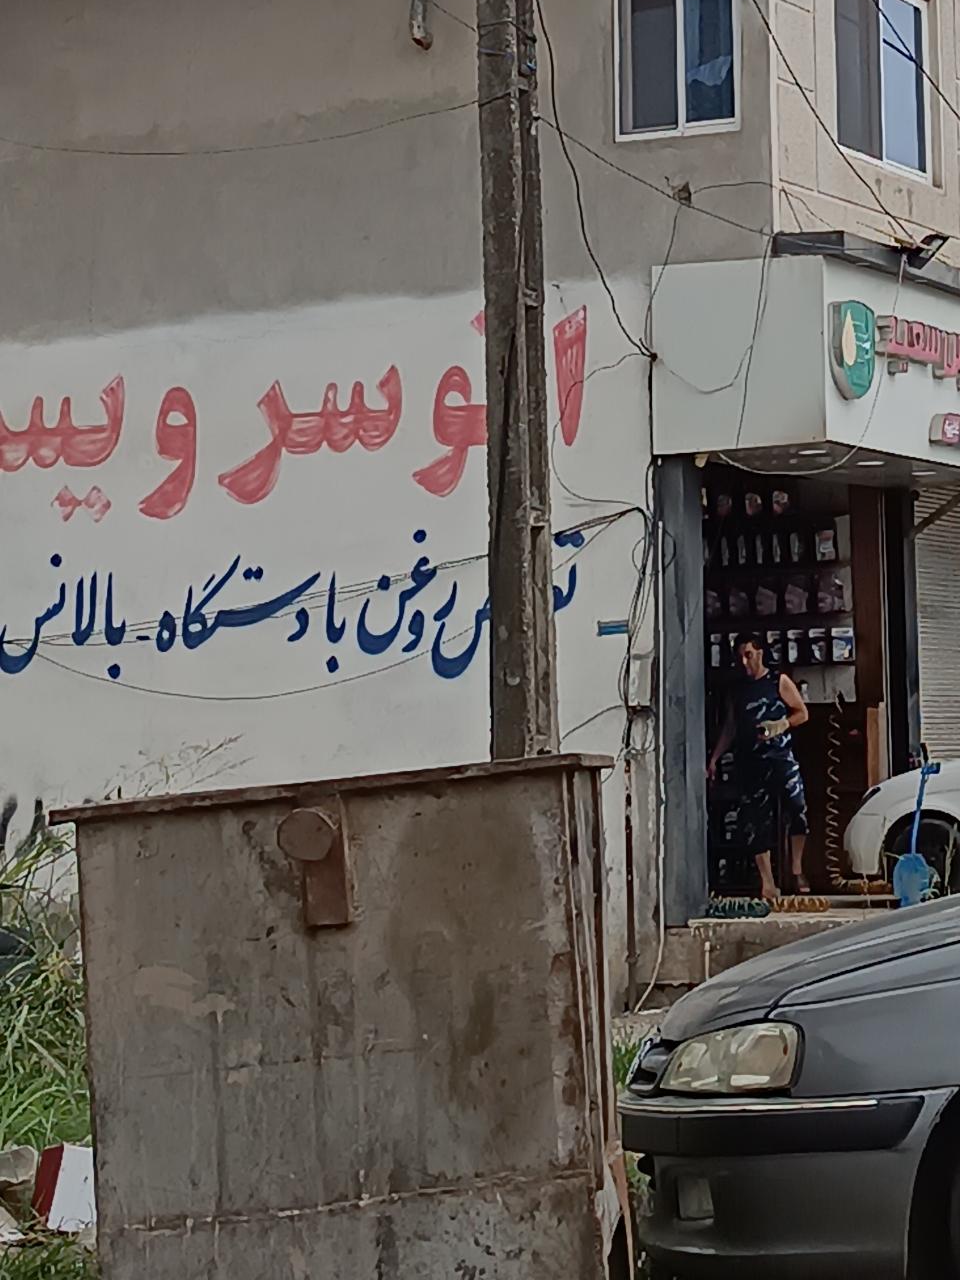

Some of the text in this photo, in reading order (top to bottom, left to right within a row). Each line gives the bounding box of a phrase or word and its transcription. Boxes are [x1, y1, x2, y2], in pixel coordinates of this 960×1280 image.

[0, 554, 127, 680] بالانس
[155, 555, 320, 652] دستگاه
[325, 571, 347, 673] با
[355, 528, 458, 657] روغن
